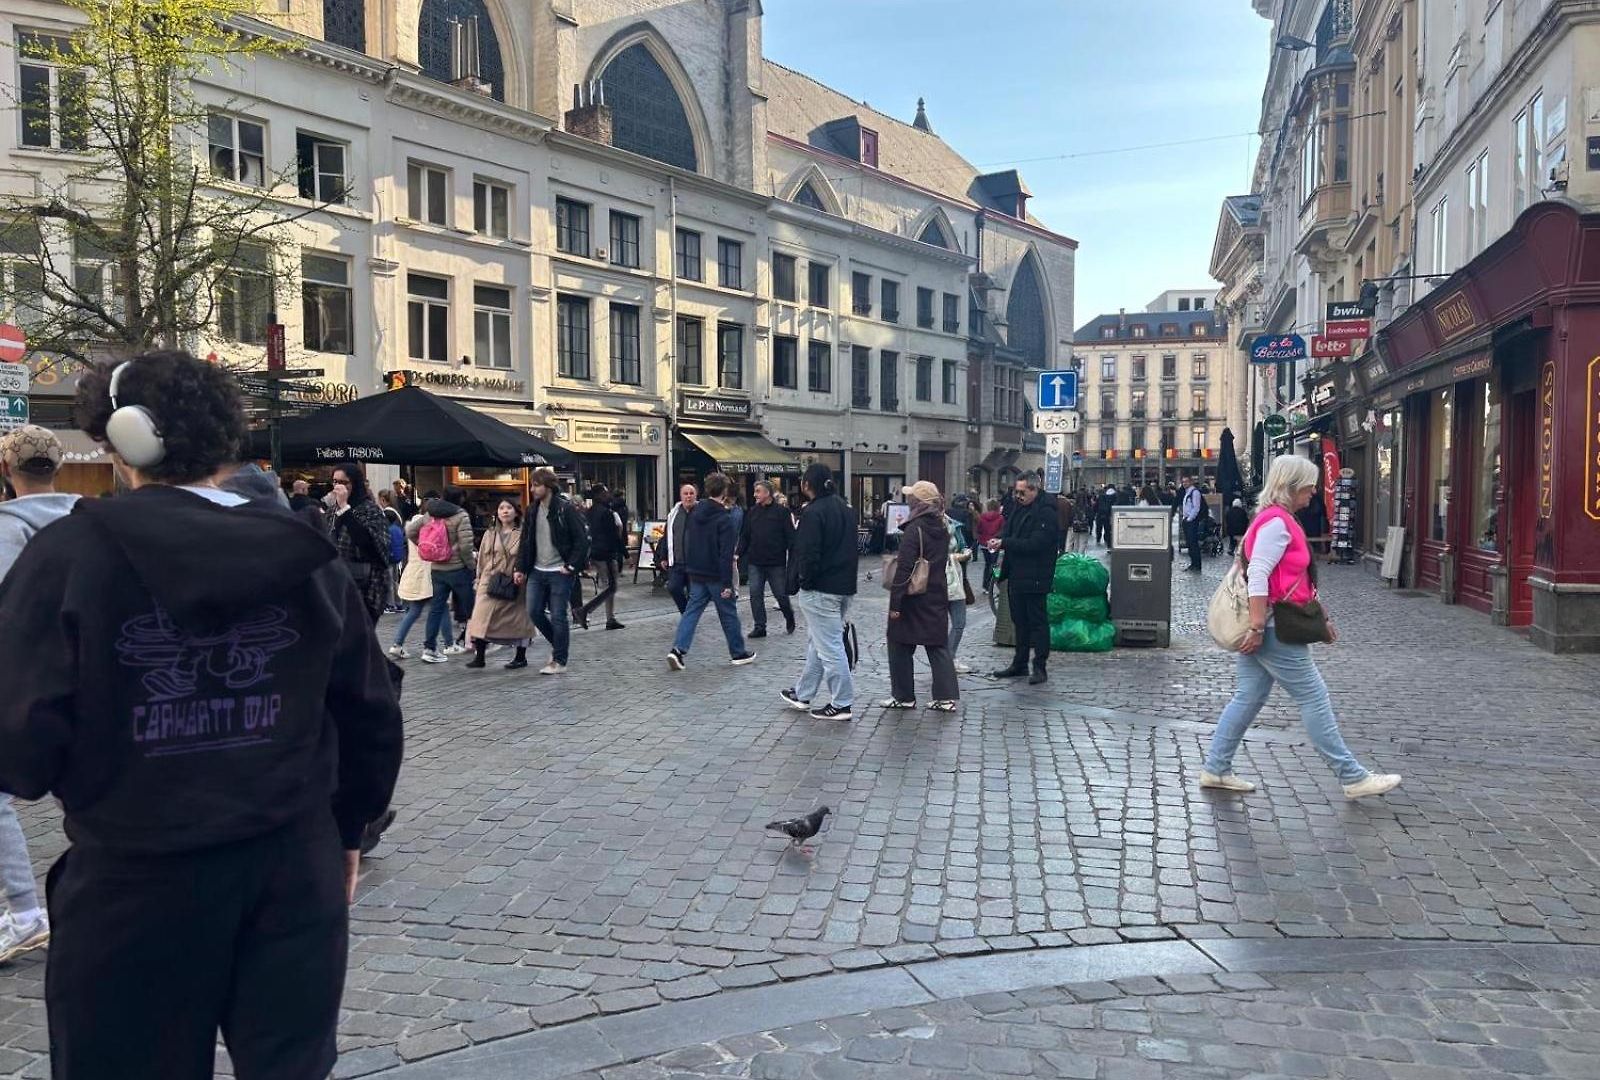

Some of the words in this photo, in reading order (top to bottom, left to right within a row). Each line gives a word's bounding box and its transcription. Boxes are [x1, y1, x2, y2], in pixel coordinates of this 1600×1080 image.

[687, 399, 697, 410] Le
[715, 401, 748, 413] Normand
[1542, 371, 1552, 507] NICOLAS
